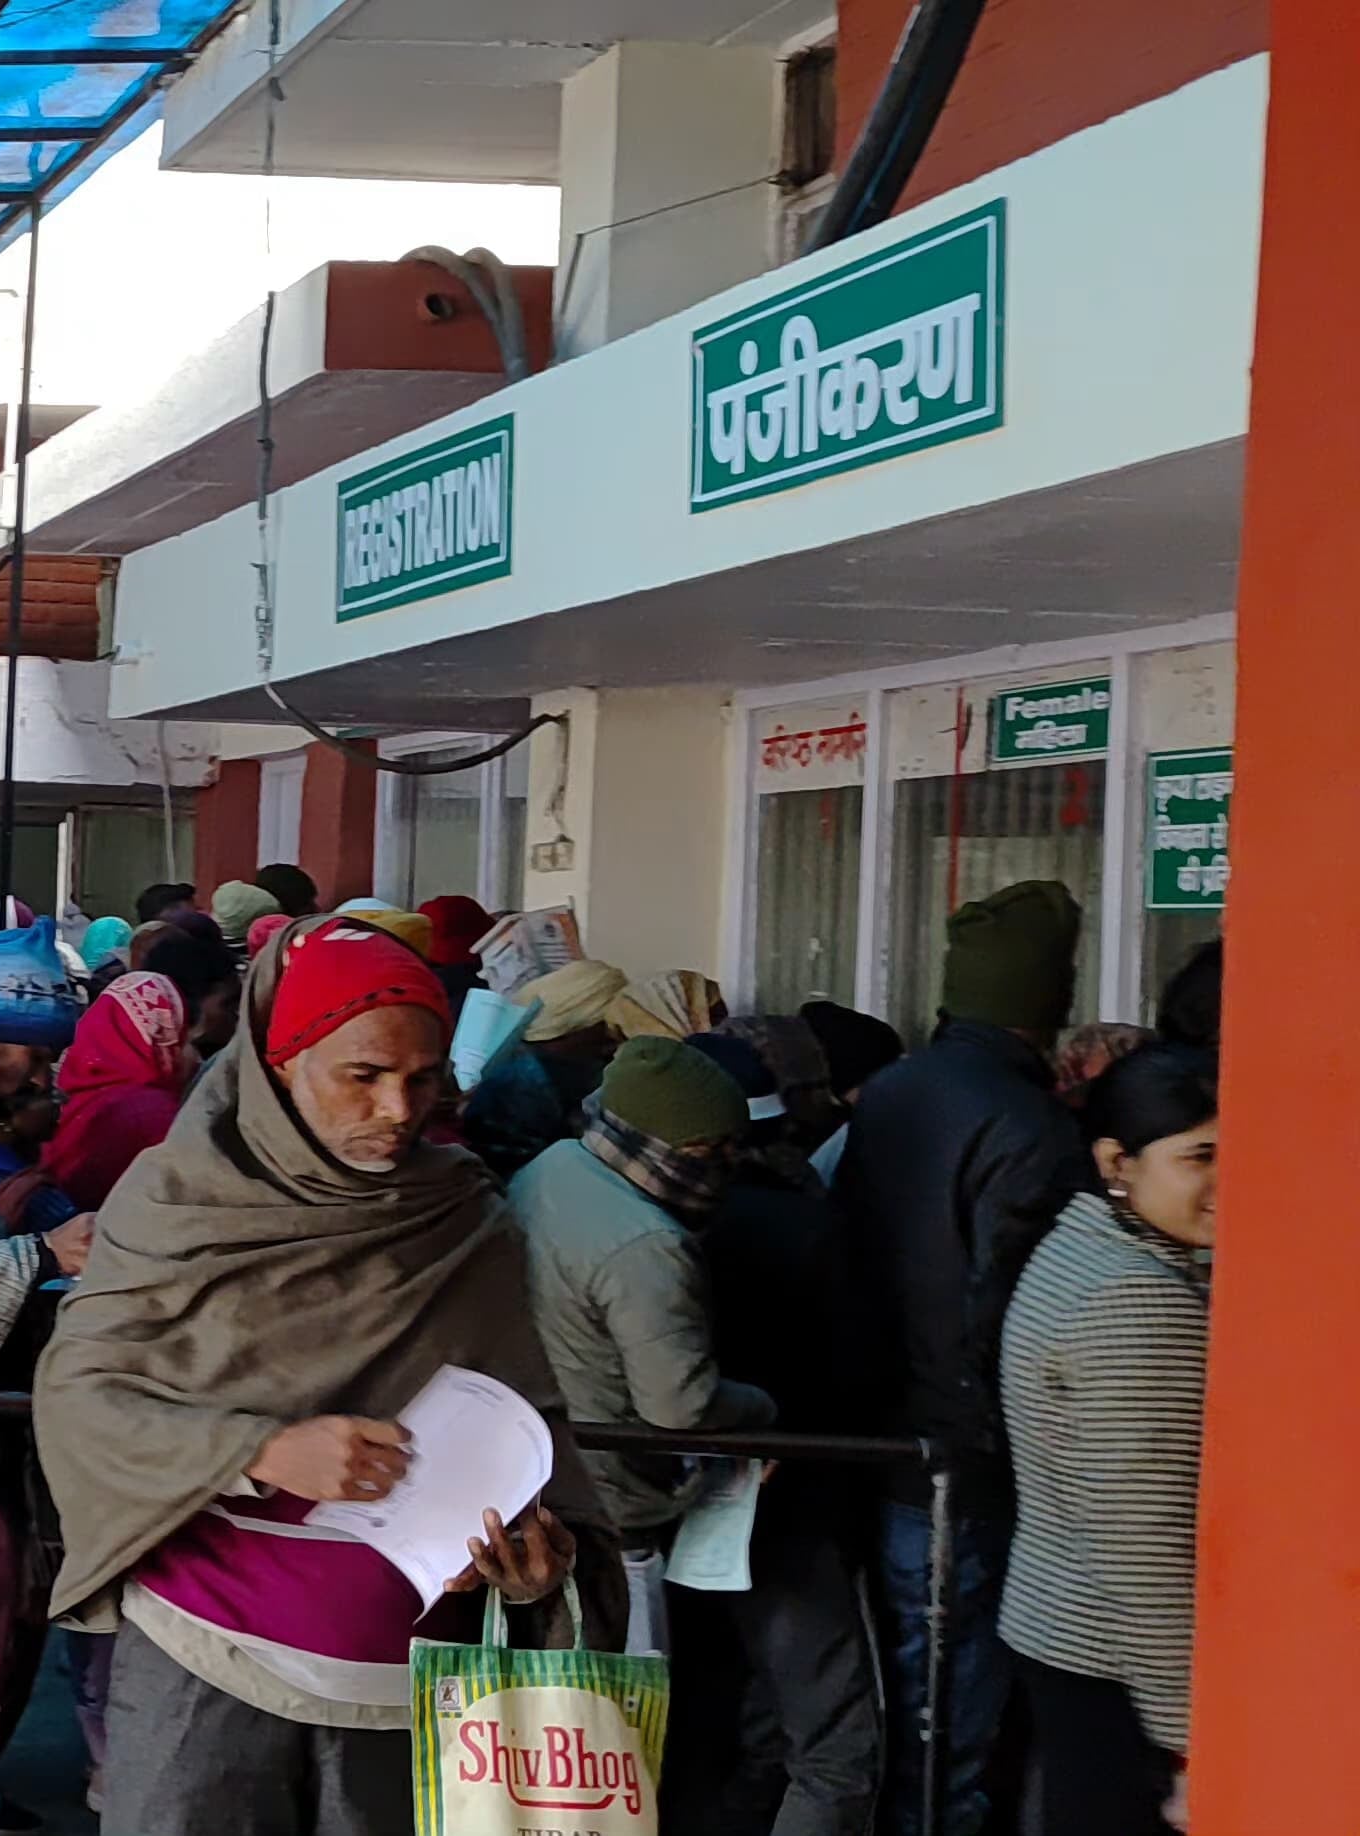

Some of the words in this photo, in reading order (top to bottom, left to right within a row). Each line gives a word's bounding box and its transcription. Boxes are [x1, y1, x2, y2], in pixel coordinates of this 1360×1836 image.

[707, 293, 981, 475] पंजीकरण
[343, 452, 501, 589] REGISTRATION
[1005, 687, 1111, 720] Female
